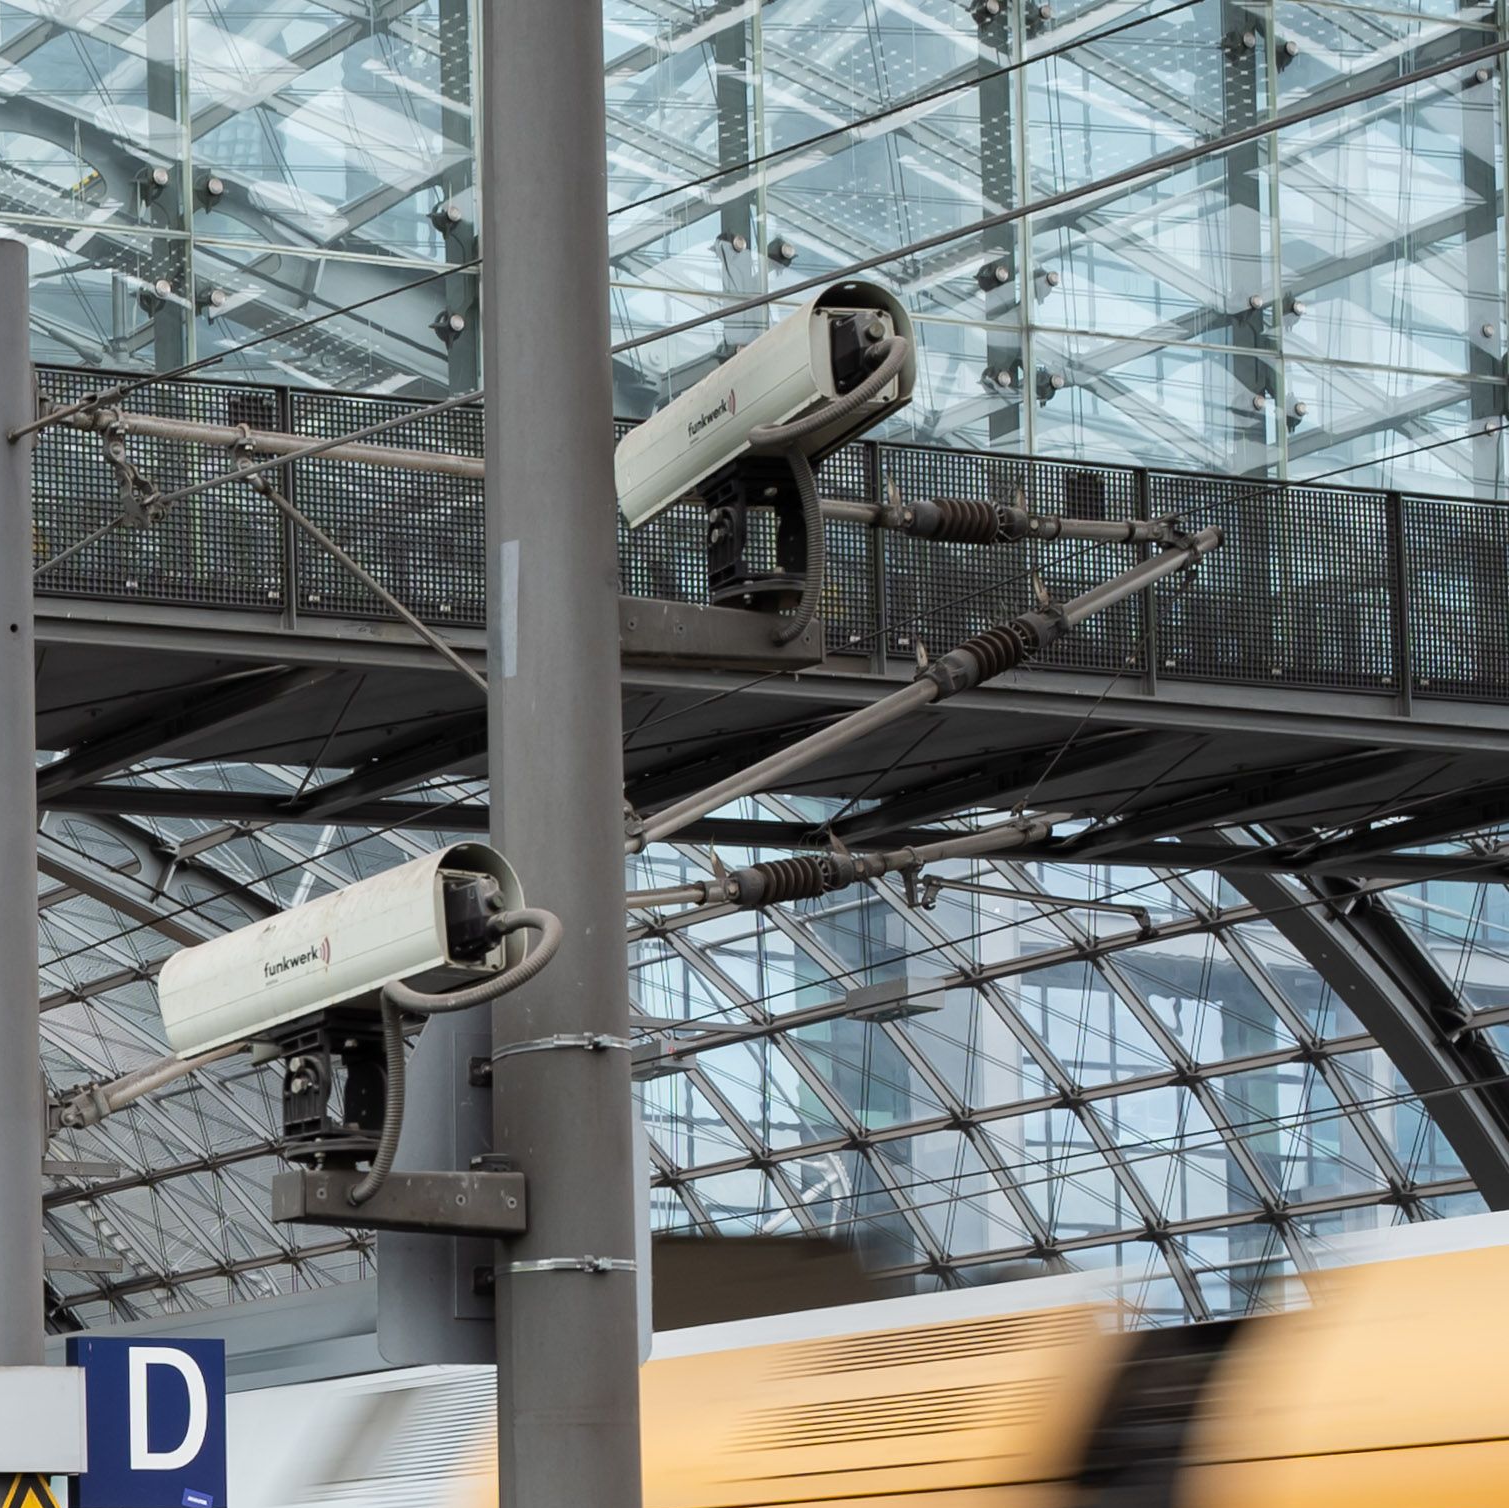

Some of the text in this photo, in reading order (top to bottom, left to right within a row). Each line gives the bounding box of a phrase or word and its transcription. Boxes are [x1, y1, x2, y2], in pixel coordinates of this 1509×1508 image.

[688, 399, 727, 437] funkwerk
[264, 945, 318, 978] funkwerk
[129, 1347, 208, 1470] D
